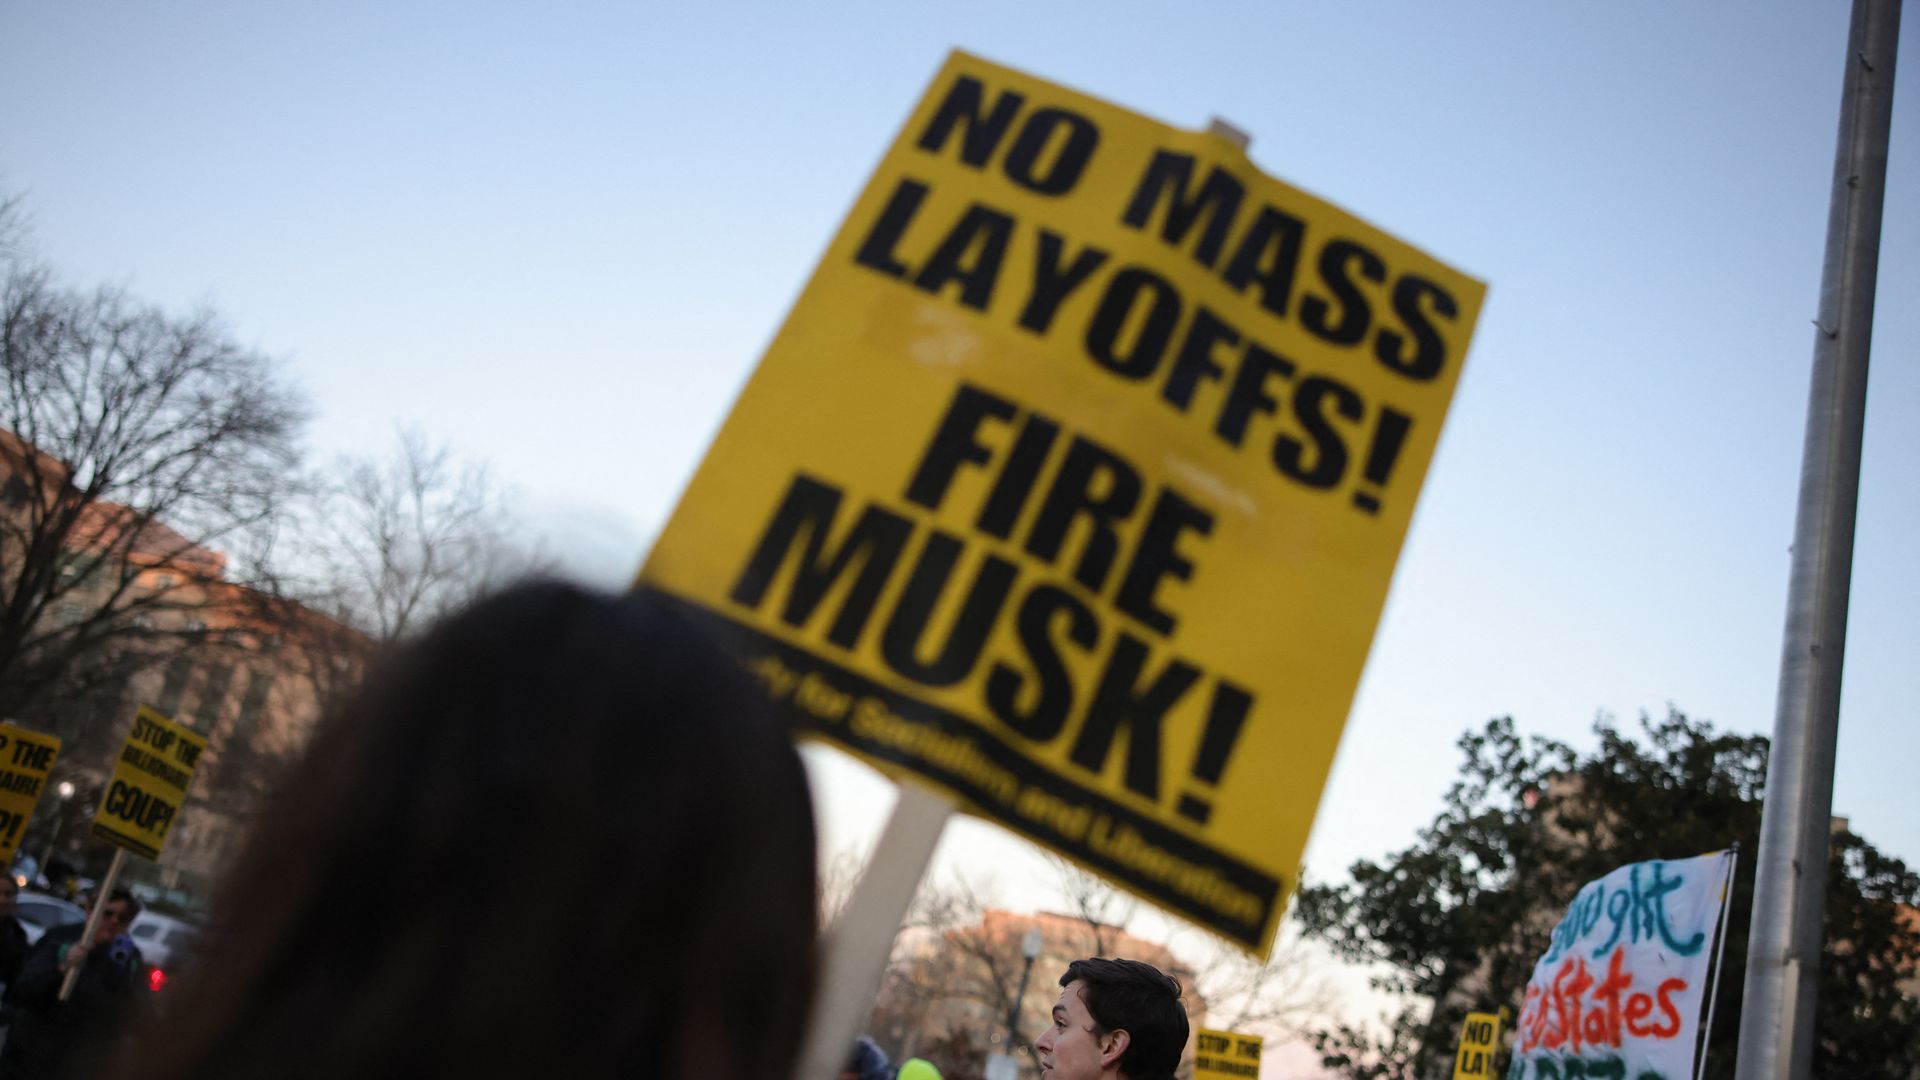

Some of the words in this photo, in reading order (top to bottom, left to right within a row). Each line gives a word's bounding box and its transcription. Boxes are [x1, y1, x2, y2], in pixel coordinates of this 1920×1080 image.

[916, 74, 1101, 197] NO
[1120, 148, 1459, 385] MASS
[851, 177, 1412, 517] LAYOFFS!
[904, 380, 1215, 638] FIRE
[730, 471, 1258, 826] MUSK!
[12, 739, 56, 771] THE
[106, 780, 176, 837] COUP!
[132, 716, 177, 752] STOP
[175, 738, 202, 768] THE
[798, 671, 851, 721] for
[850, 697, 1018, 800] Socialism
[1016, 786, 1092, 843] and
[1087, 813, 1263, 928] Liberation
[1198, 1033, 1230, 1054] STOP
[1236, 1040, 1260, 1061] THE
[1464, 1021, 1493, 1045] NO
